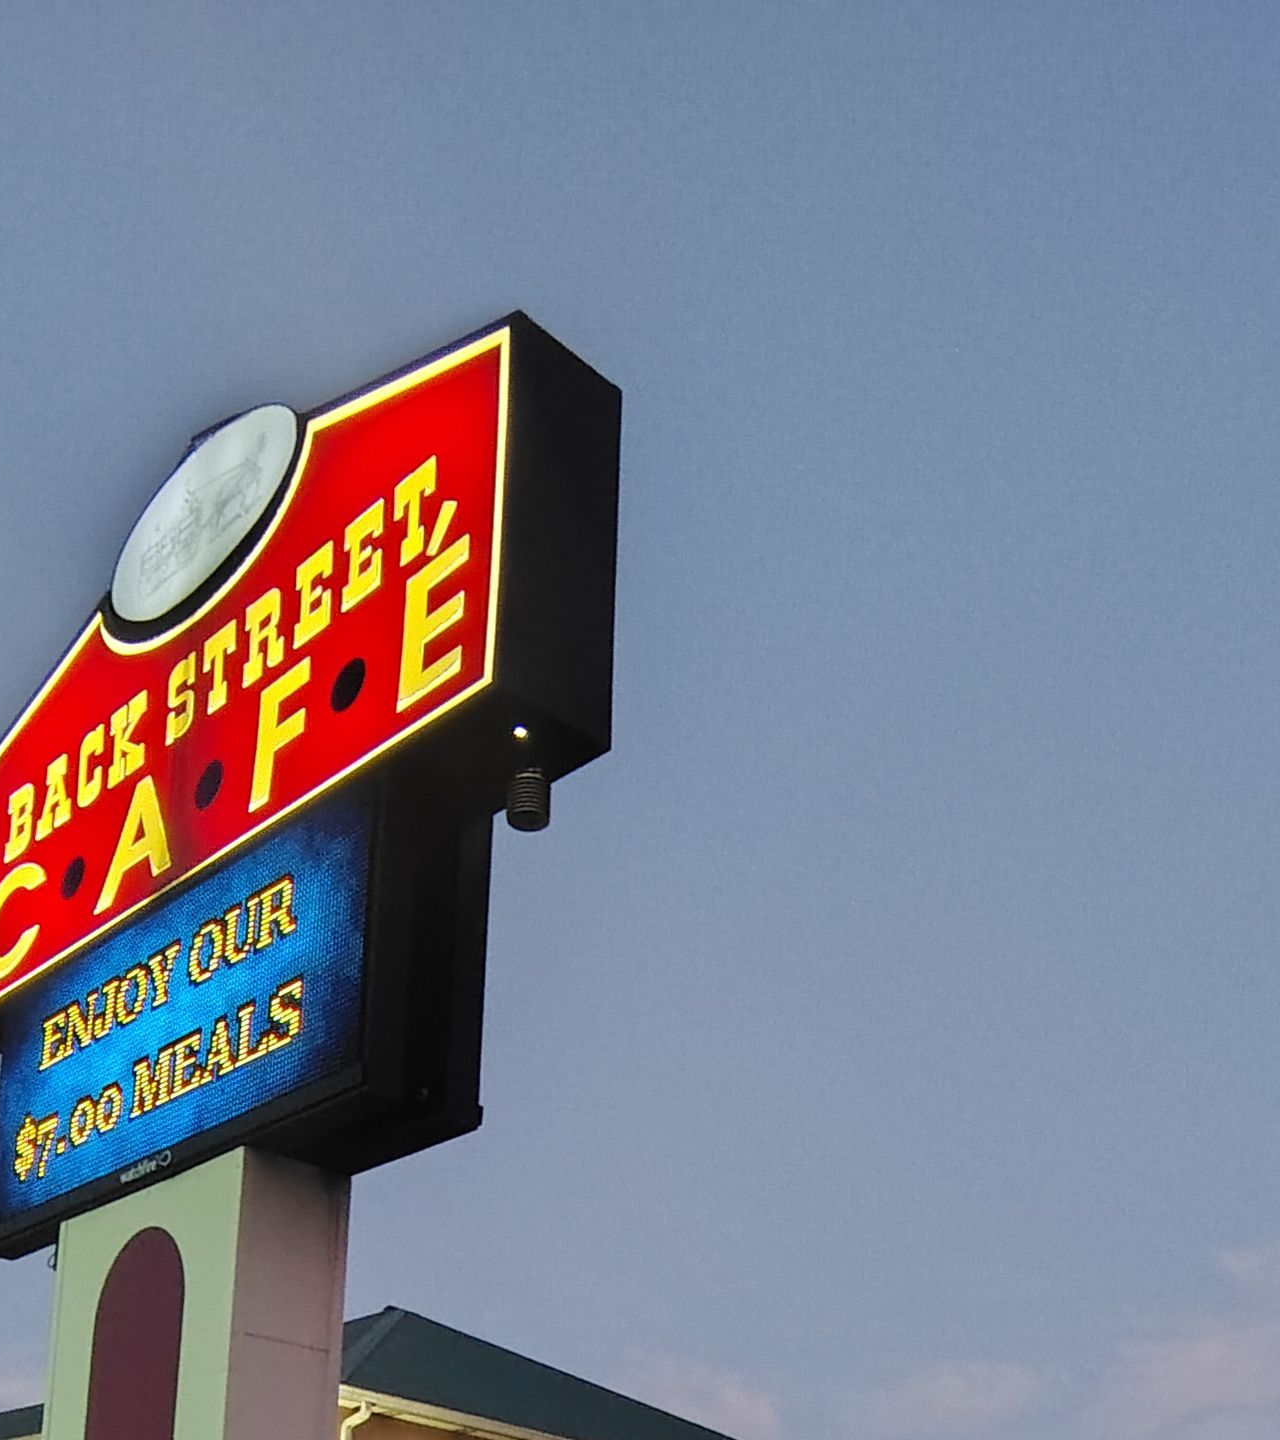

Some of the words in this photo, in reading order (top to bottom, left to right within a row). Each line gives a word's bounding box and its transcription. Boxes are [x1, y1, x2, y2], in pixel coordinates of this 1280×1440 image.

[3, 690, 148, 864] BACK
[164, 455, 438, 747] STREET
[38, 940, 181, 1071] ENJOY
[188, 874, 298, 984] OUR
[13, 1082, 123, 1182] $7.00
[129, 976, 304, 1119] MEALS
